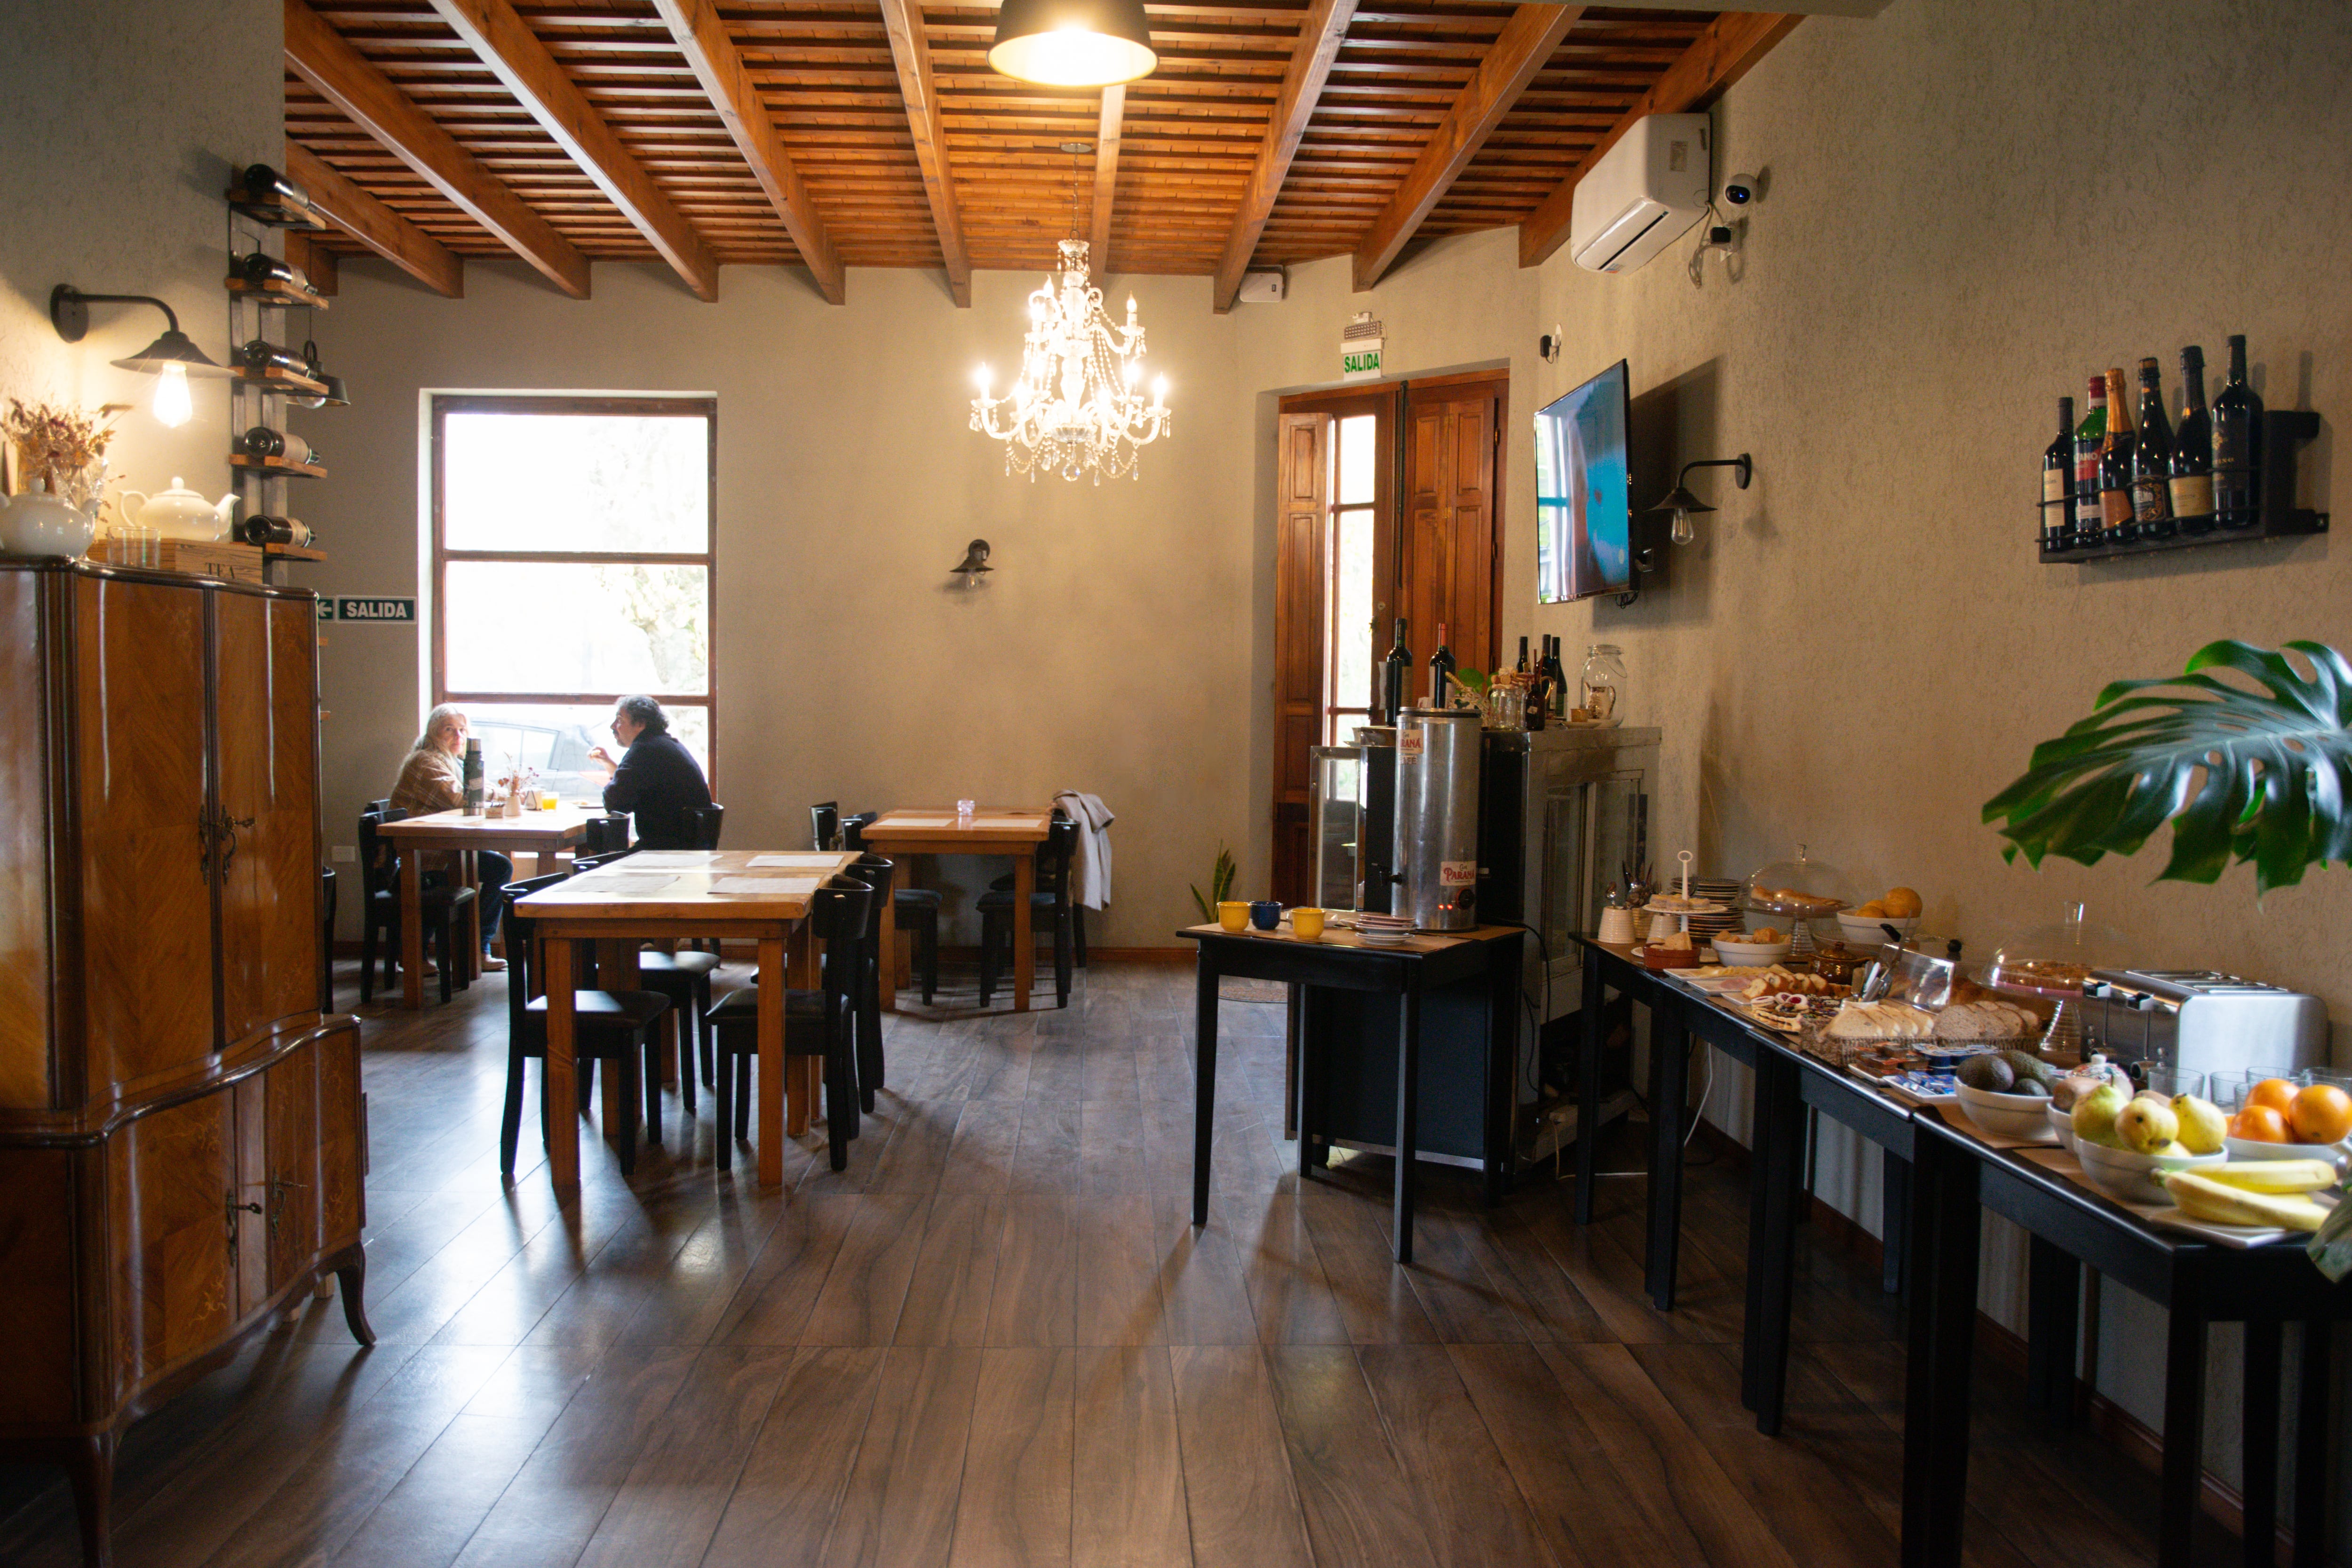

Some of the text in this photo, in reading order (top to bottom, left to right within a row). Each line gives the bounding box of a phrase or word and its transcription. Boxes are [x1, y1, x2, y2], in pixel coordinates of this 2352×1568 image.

[1344, 353, 1380, 373] SALIDA
[206, 562, 234, 579] TEA
[347, 602, 407, 618] SALIDA
[1398, 737, 1422, 748] RANÁ
